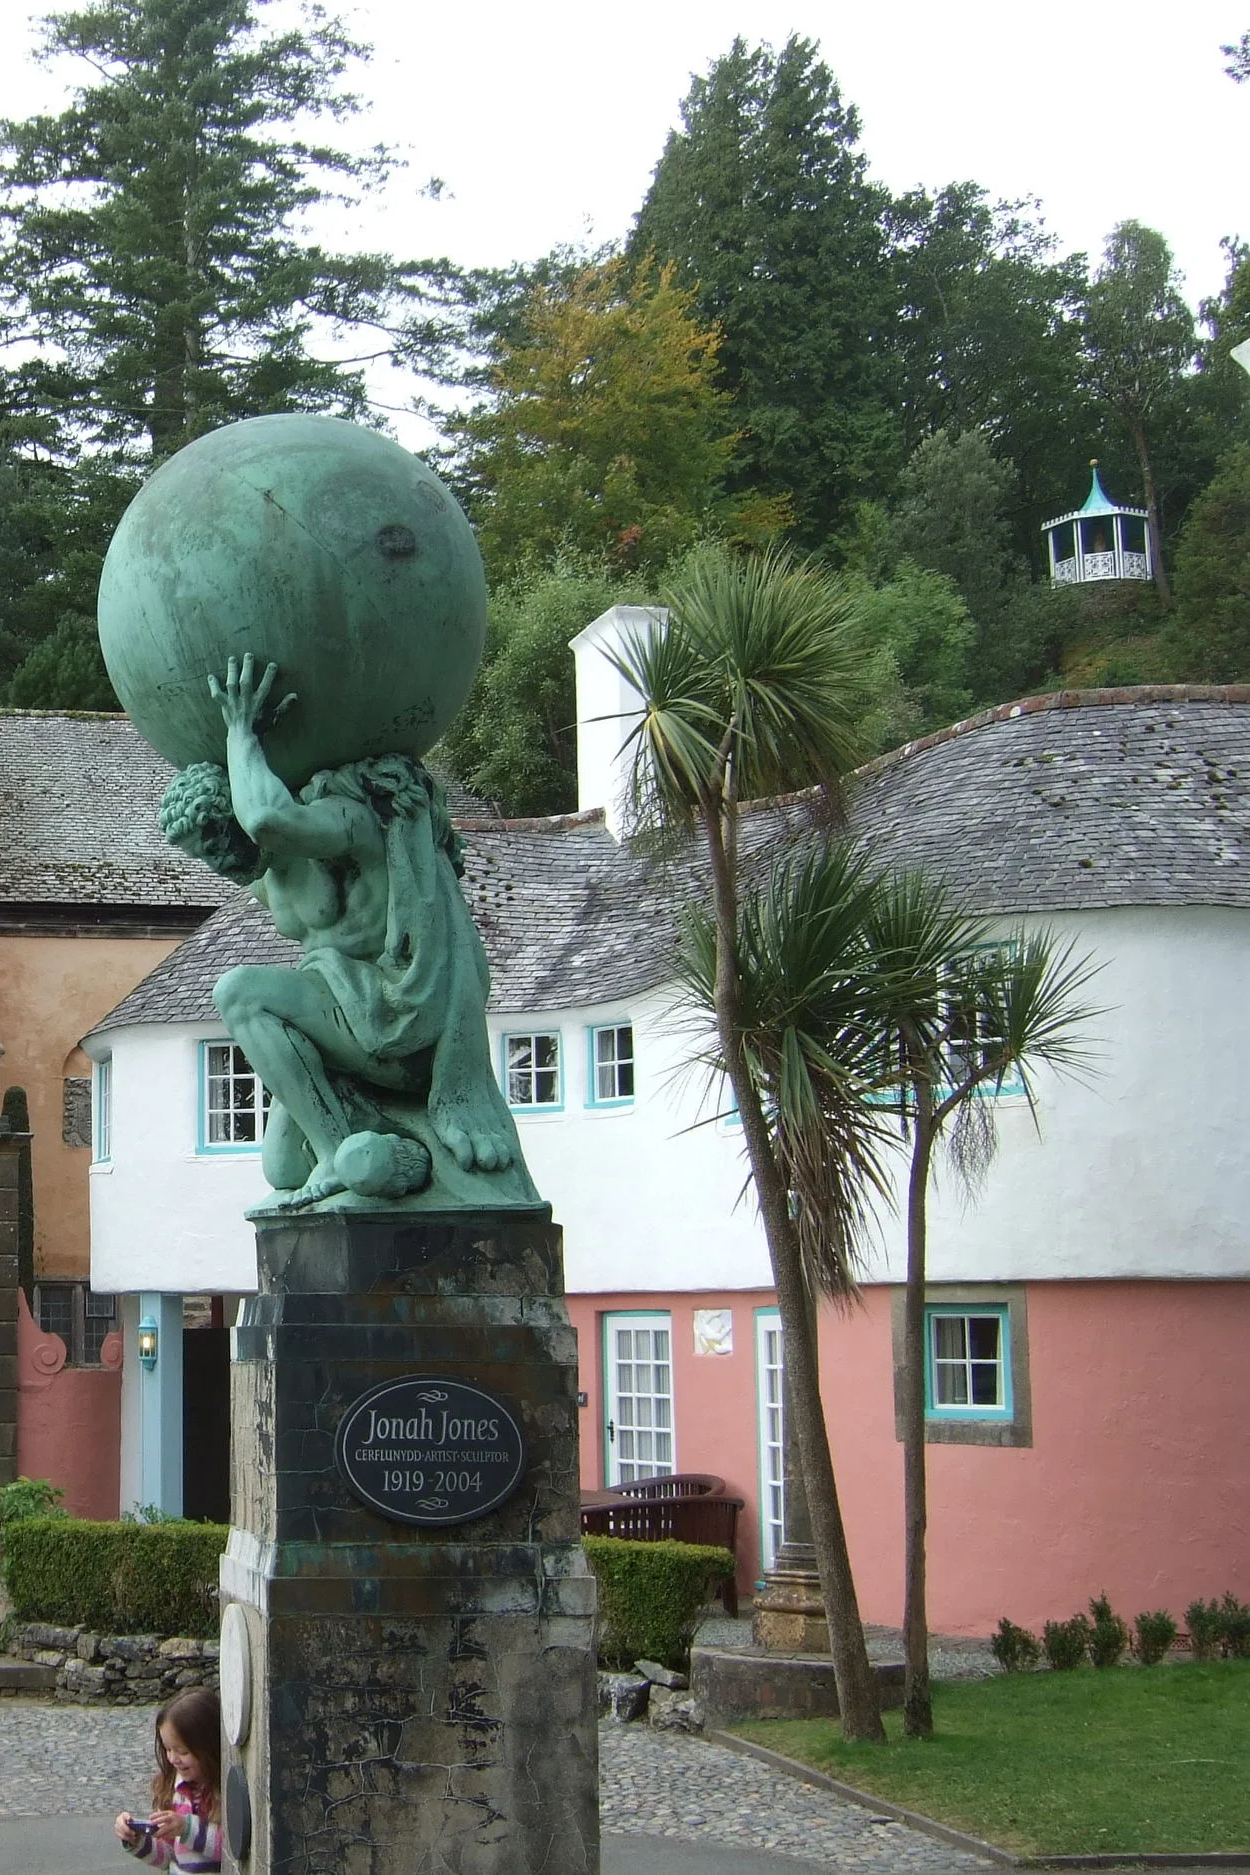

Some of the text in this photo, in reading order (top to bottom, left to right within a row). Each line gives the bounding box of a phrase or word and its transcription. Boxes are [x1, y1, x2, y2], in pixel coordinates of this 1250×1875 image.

[361, 1407, 500, 1446] Jonah Jones
[382, 1470, 424, 1492] 1919
